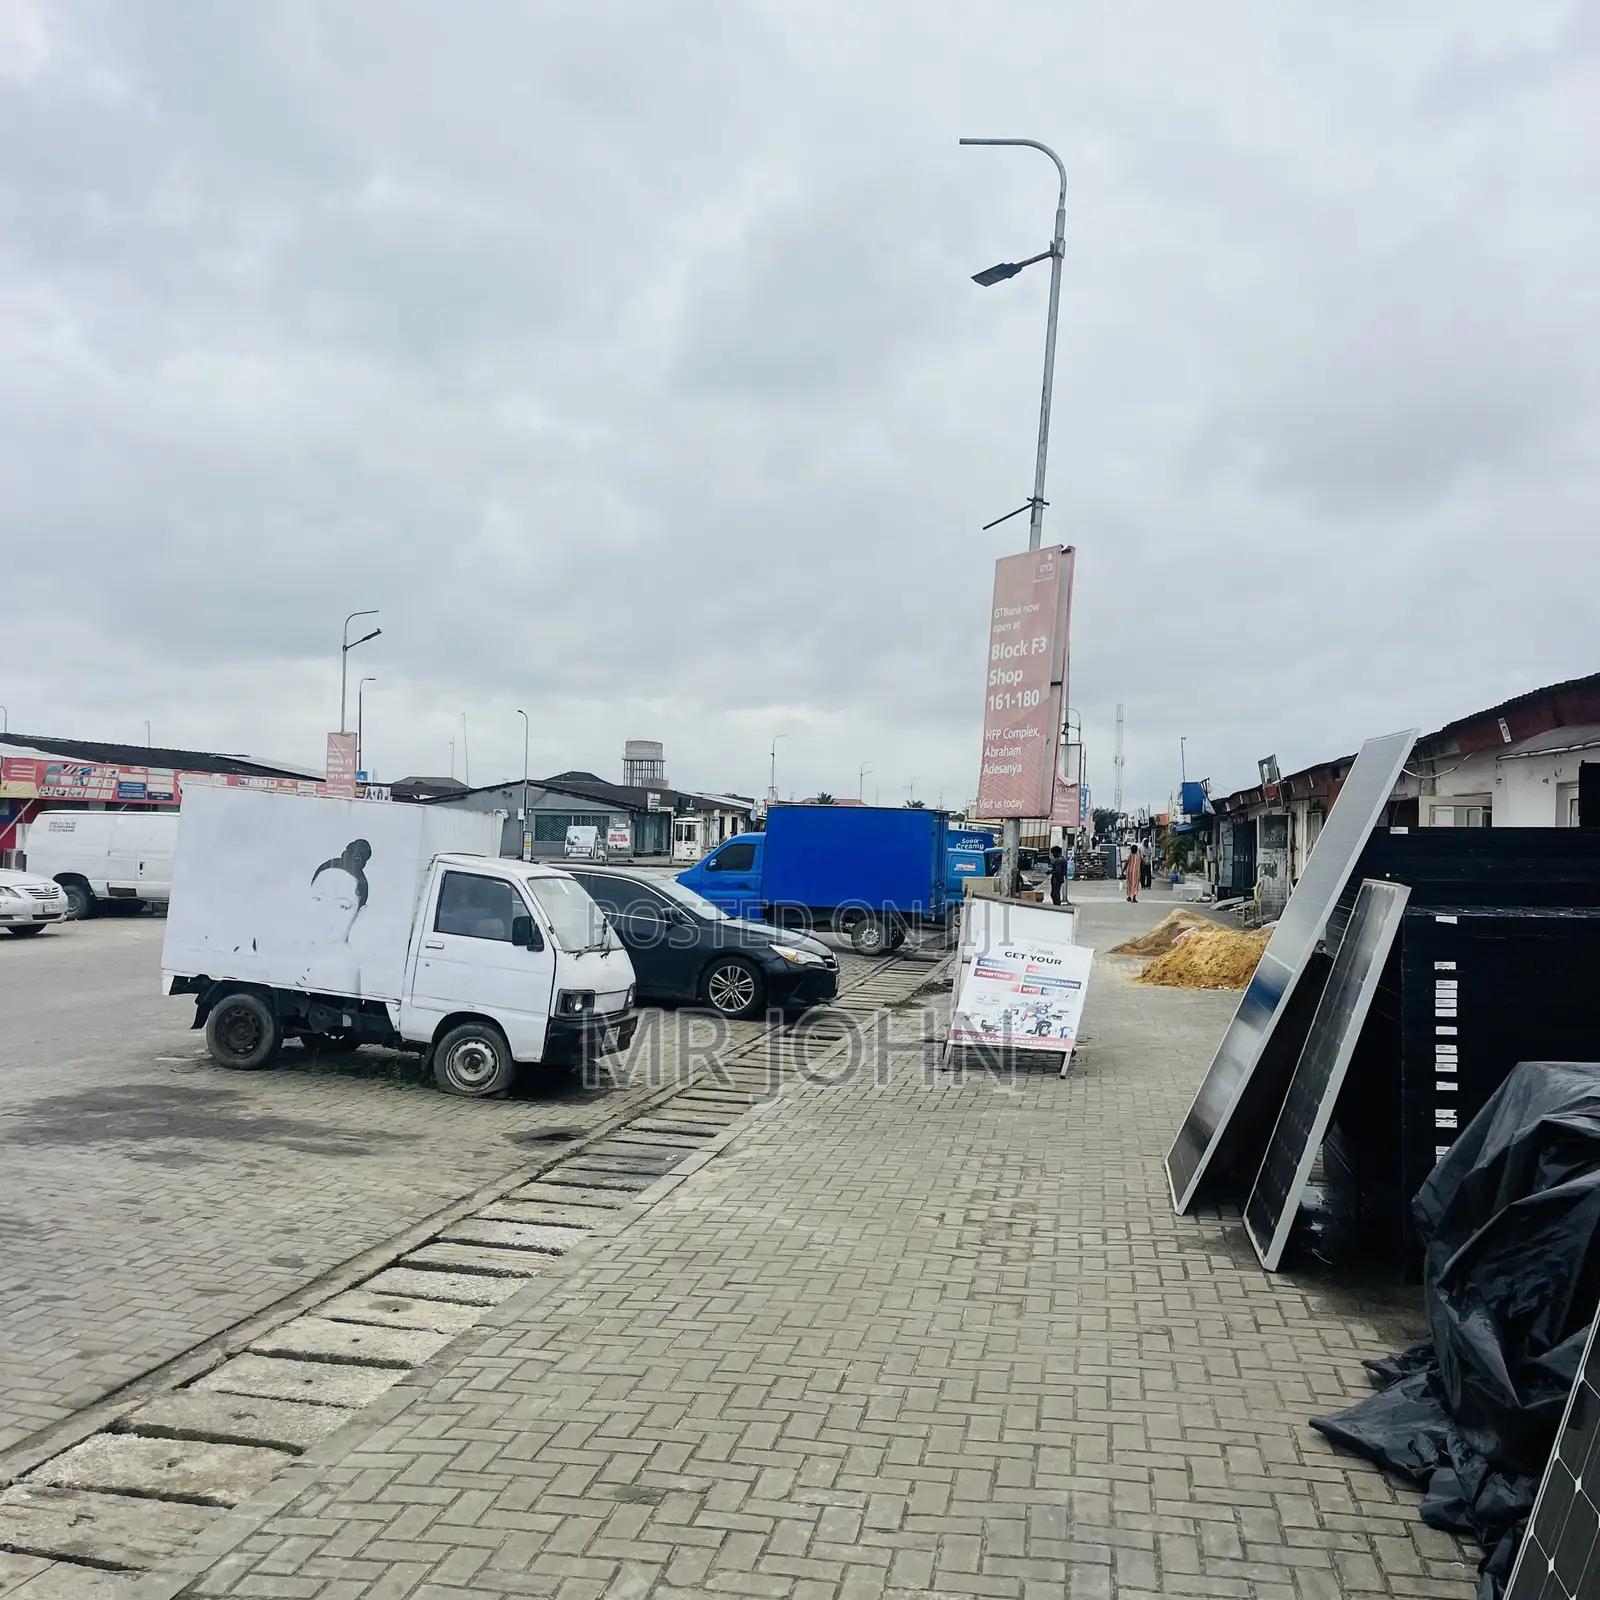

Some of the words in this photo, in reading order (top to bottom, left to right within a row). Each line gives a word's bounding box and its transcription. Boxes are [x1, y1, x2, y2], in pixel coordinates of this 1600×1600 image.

[993, 605, 1021, 619] GTBank
[1022, 603, 1041, 614] now
[992, 622, 1011, 635] open
[1012, 619, 1021, 630] at
[991, 639, 1028, 661] Block
[1031, 636, 1048, 655] F3
[989, 667, 1023, 687] Shop
[988, 689, 1040, 711] 161-180
[985, 728, 1002, 740] HFP
[1003, 724, 1041, 740] Complex,
[983, 745, 1022, 758] Abraham
[982, 762, 1022, 776] Adesanya
[1003, 798, 1025, 810] today
[955, 842, 985, 851] Creamy
[1004, 951, 1028, 961] GET
[1029, 955, 1063, 966] YOUR
[976, 970, 1011, 979] PRINTING
[1024, 976, 1080, 988] MONOGRAMING
